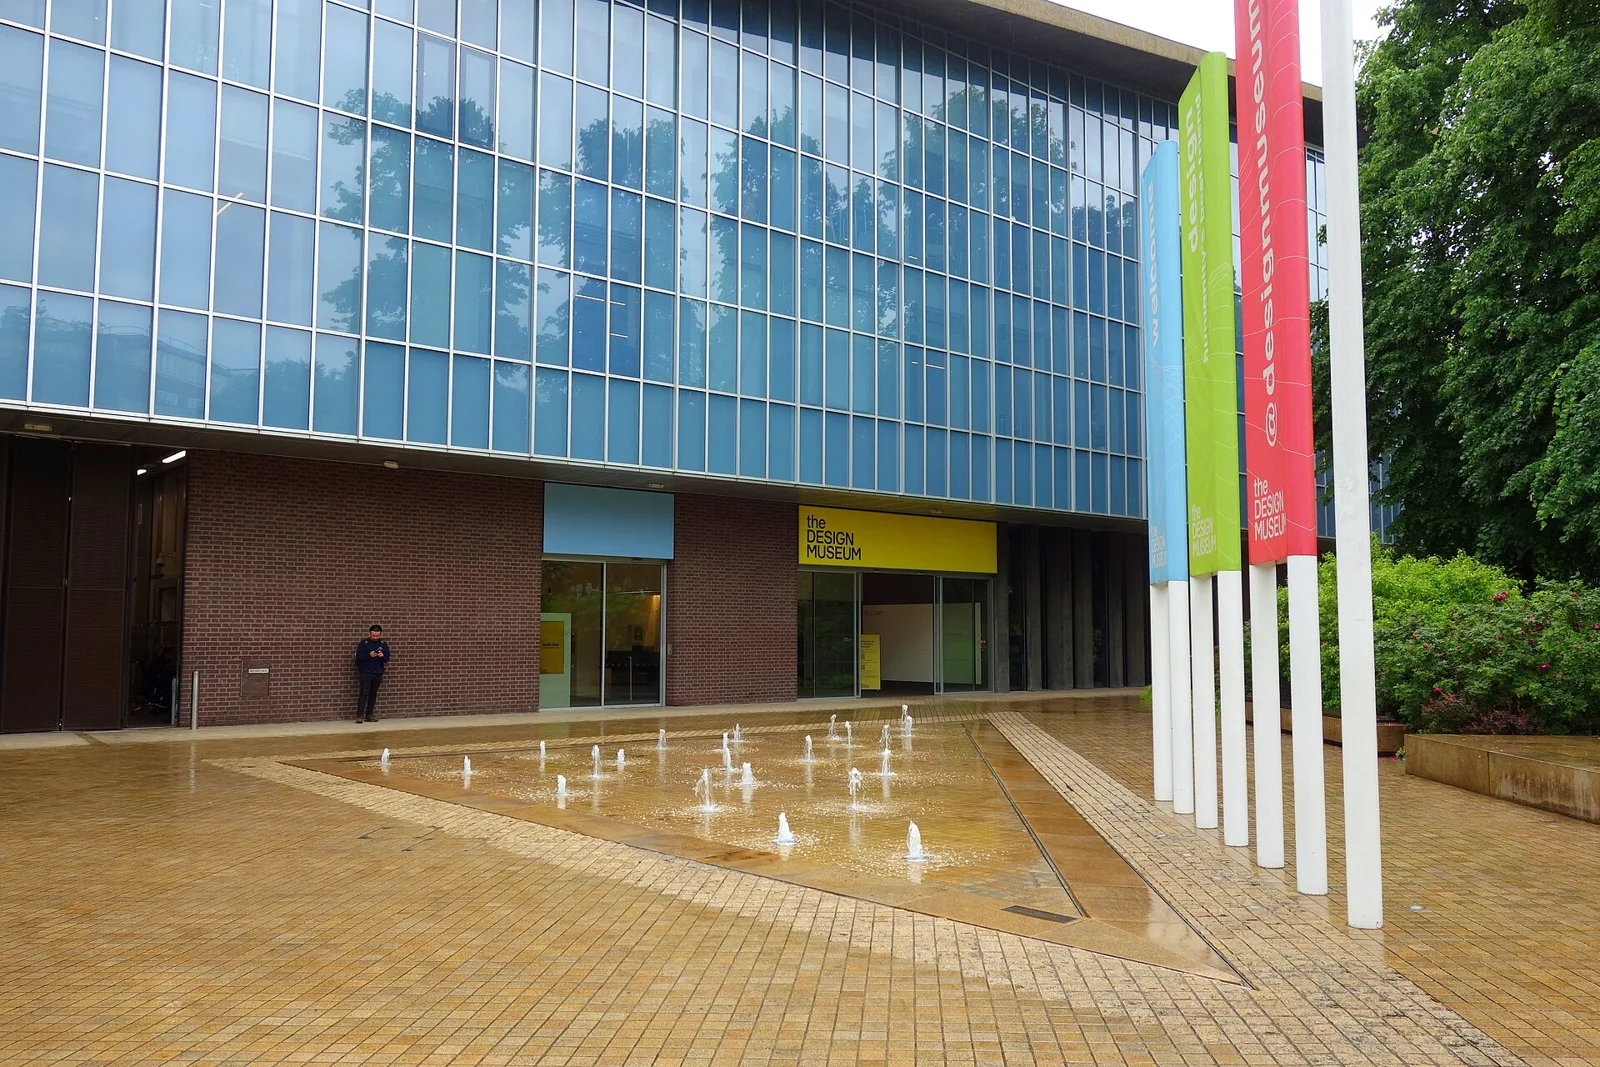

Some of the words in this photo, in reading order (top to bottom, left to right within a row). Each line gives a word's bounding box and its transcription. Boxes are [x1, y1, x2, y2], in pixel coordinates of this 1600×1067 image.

[1186, 108, 1198, 252] design
[1148, 181, 1159, 348] welcome
[1253, 477, 1268, 498] the
[1254, 490, 1284, 520] DESIGN
[806, 514, 826, 530] the
[1191, 515, 1214, 540] DESIGN
[806, 529, 854, 546] DESIGN
[1192, 534, 1216, 556] MUSEUM
[806, 544, 862, 561] MUSEUM
